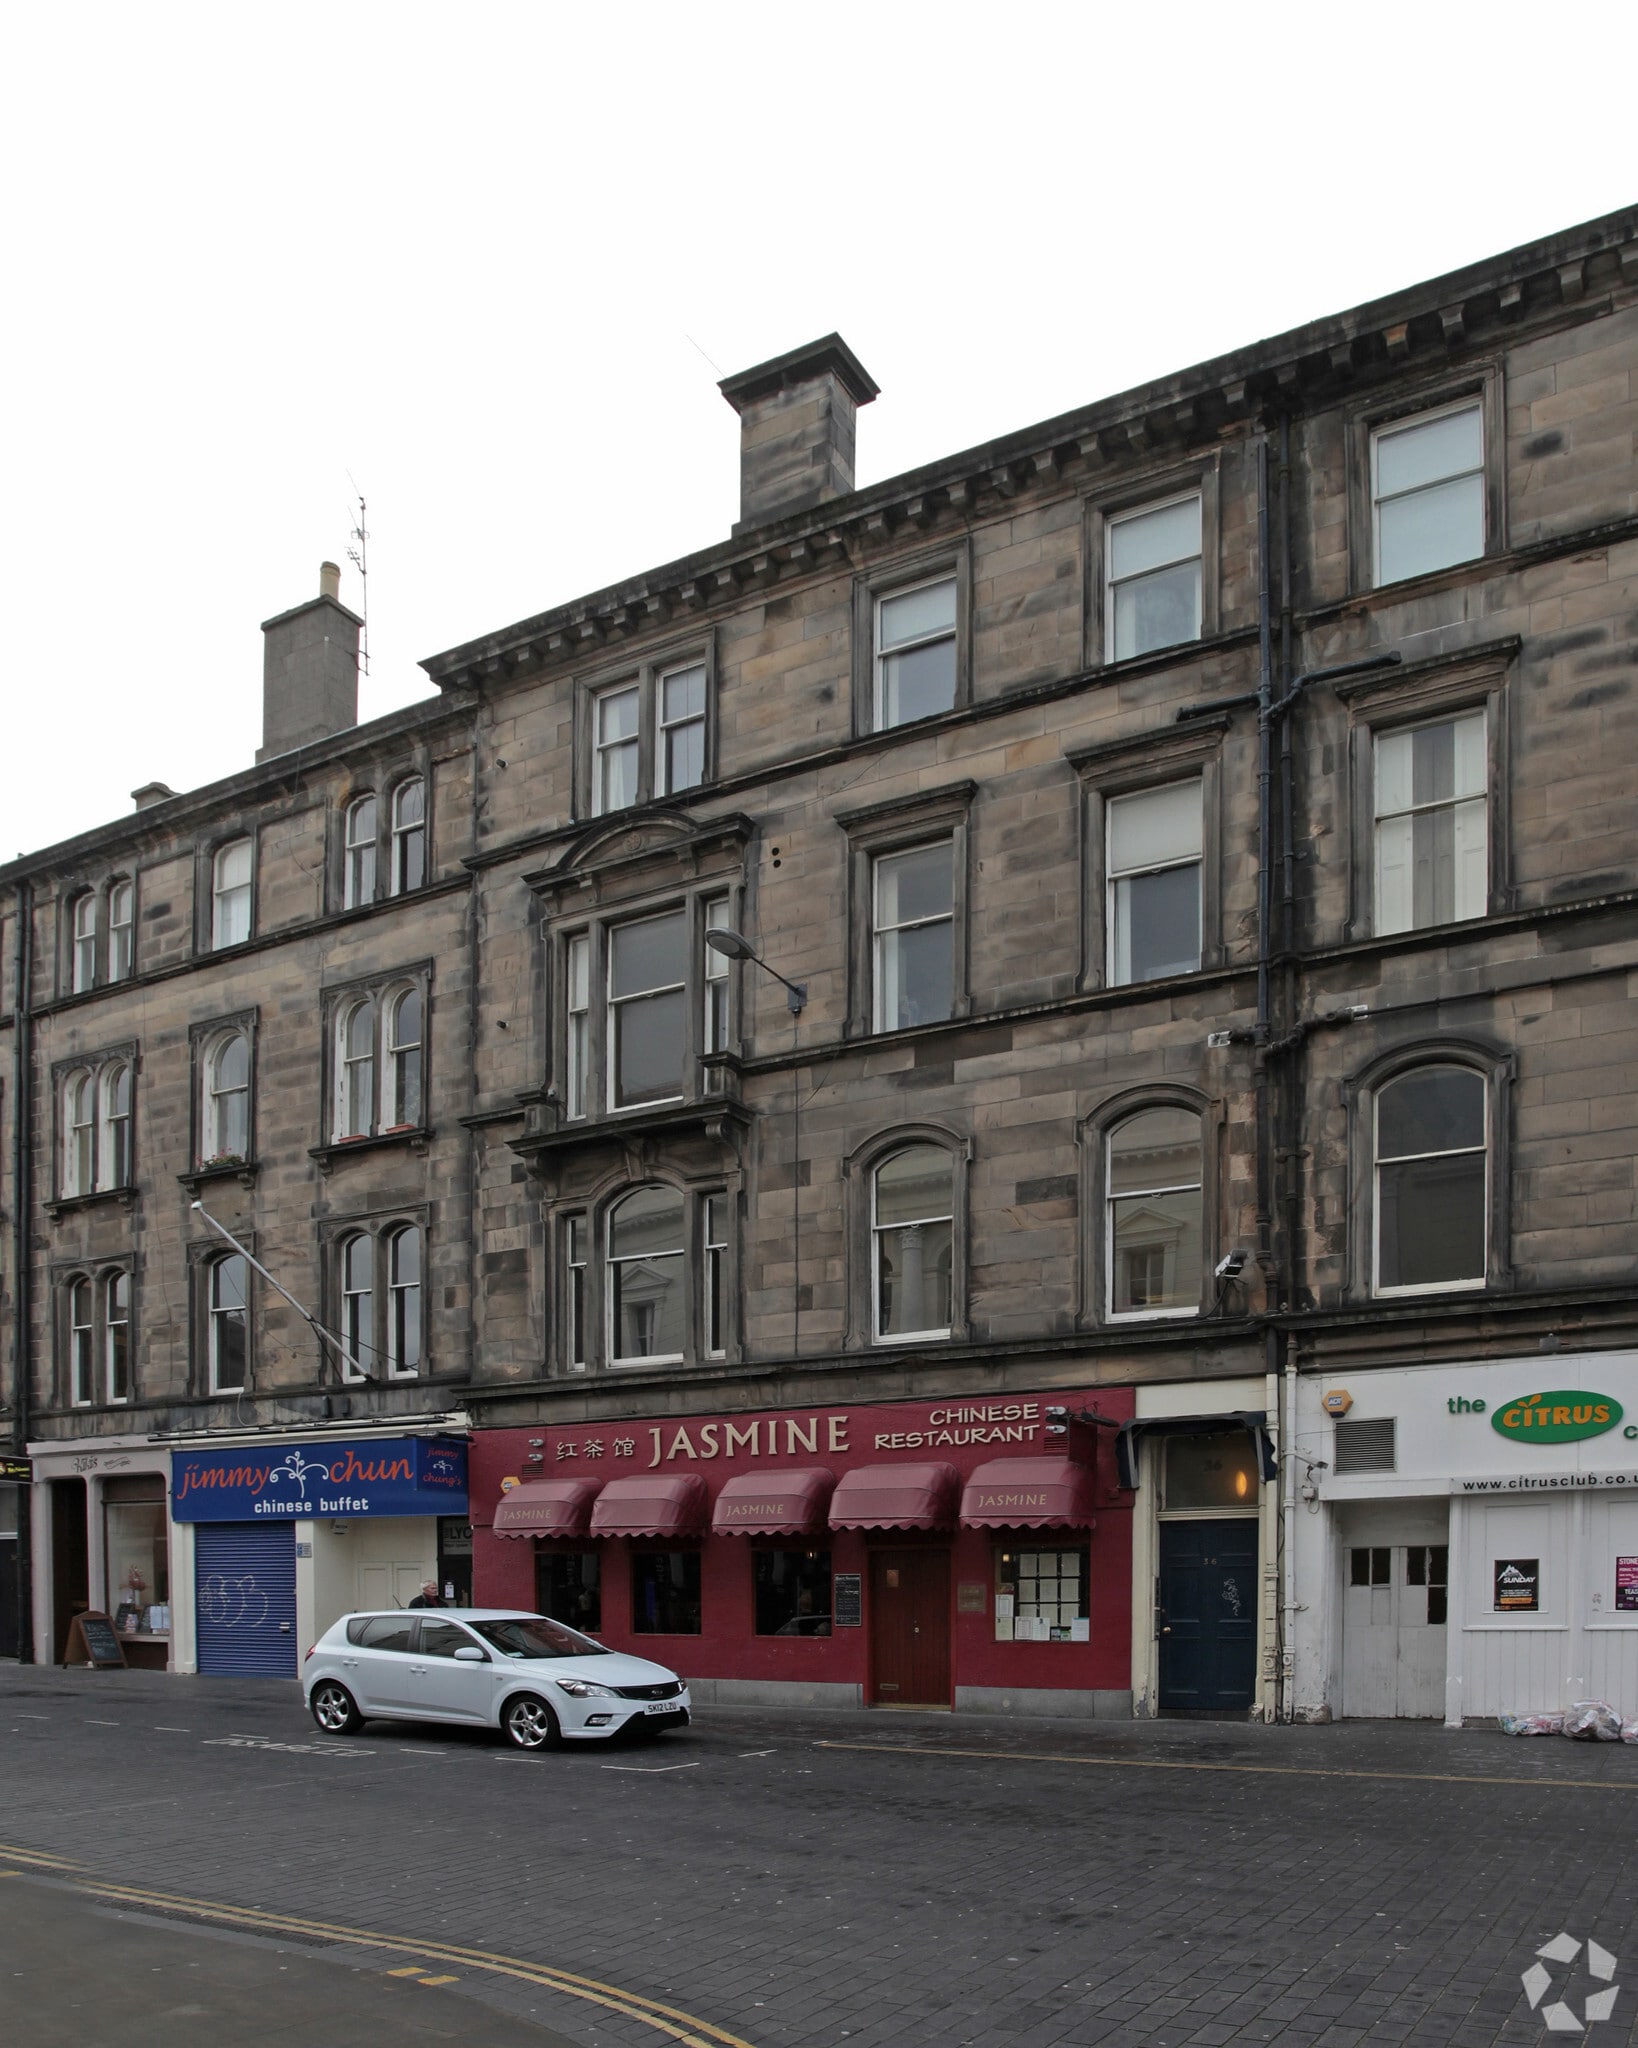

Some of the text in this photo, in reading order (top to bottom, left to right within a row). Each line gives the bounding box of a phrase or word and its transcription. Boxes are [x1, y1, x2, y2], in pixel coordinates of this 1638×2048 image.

[929, 1403, 1040, 1425] CHINESE
[1448, 1396, 1486, 1415] the
[1503, 1401, 1610, 1428] CITRUS
[648, 1415, 850, 1467] JASMINE
[874, 1424, 1040, 1450] RESTAURANT
[556, 1437, 635, 1460] 红茶馆
[177, 1450, 415, 1499] jimmy chun
[254, 1497, 369, 1514] chinese buffet
[726, 1504, 784, 1517] JASMINE
[978, 1494, 1047, 1508] JASMINE
[503, 1509, 552, 1520] JASMINE
[648, 1703, 664, 1713] SK12
